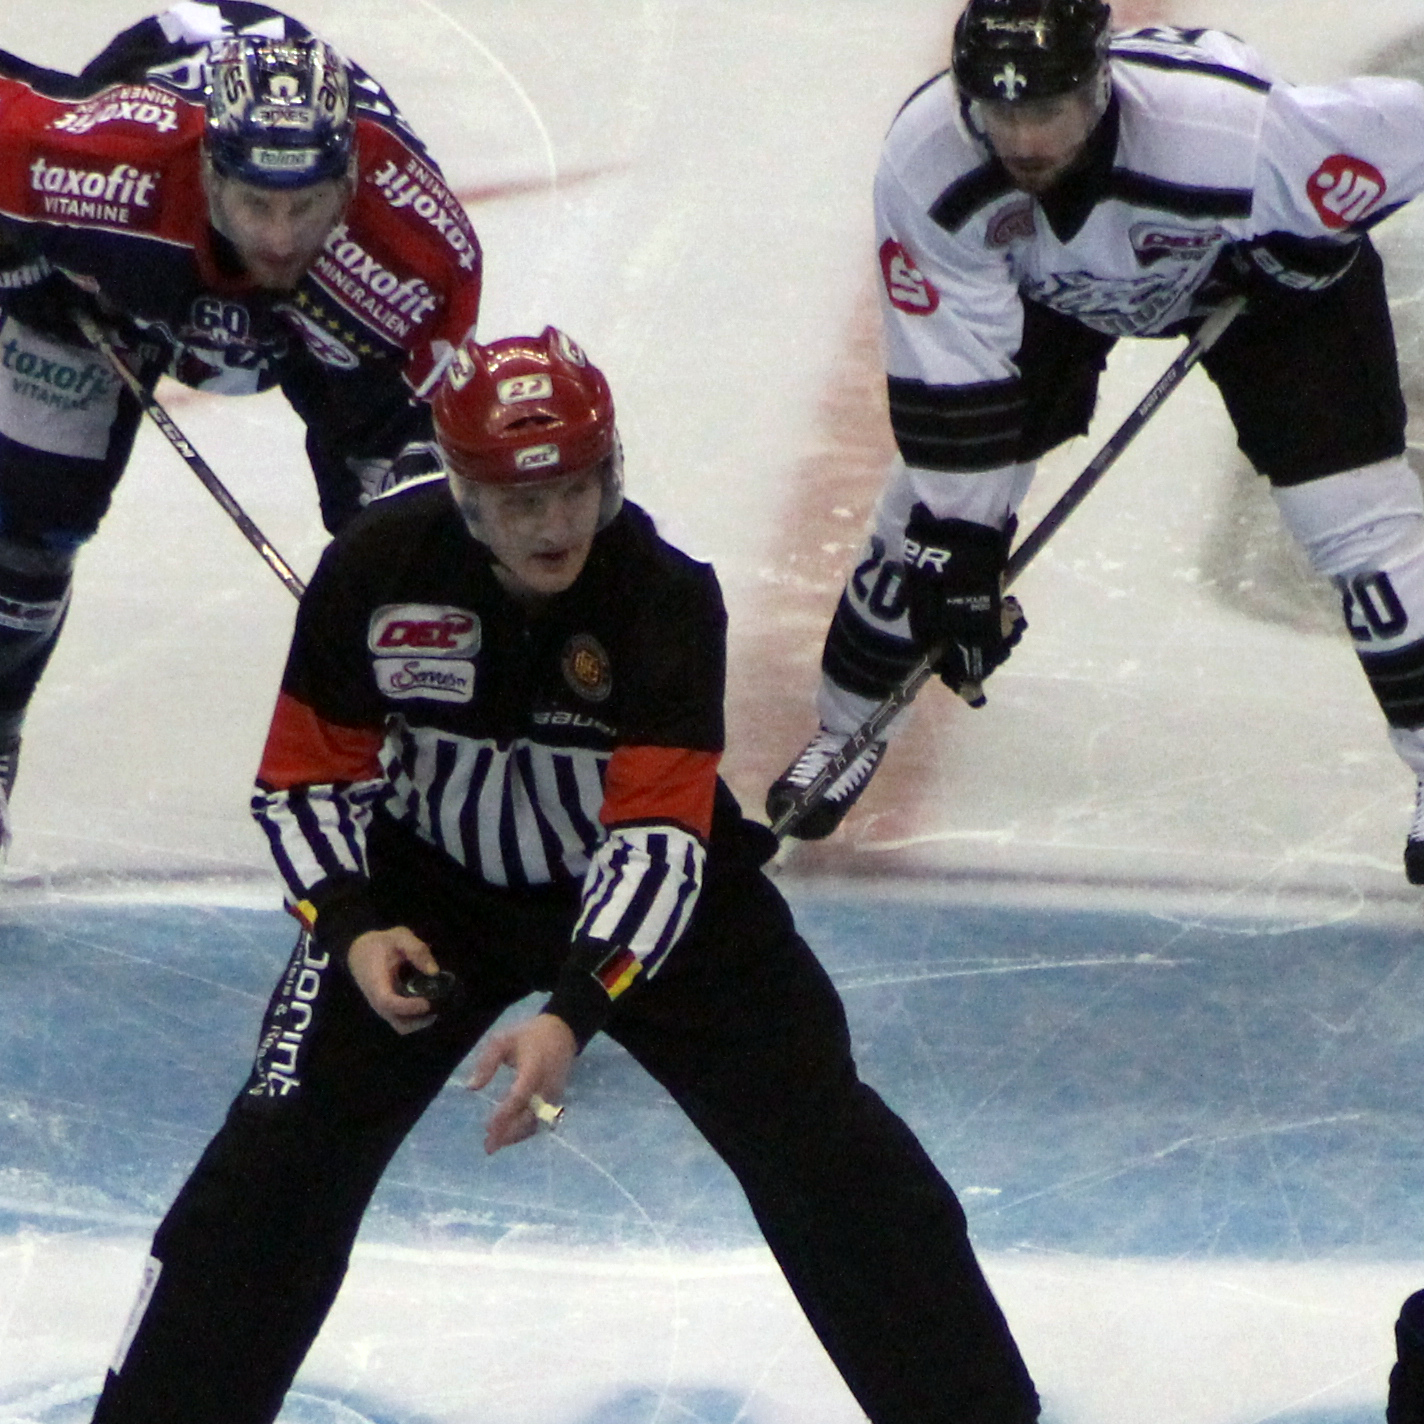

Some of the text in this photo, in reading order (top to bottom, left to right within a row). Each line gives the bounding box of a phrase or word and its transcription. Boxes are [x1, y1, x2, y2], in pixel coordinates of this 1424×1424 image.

[29, 157, 155, 208] taxofit
[44, 195, 130, 224] VITAMINE
[374, 159, 476, 272] taxofit
[314, 255, 412, 338] MINERALIEN
[325, 221, 437, 326] taxofit
